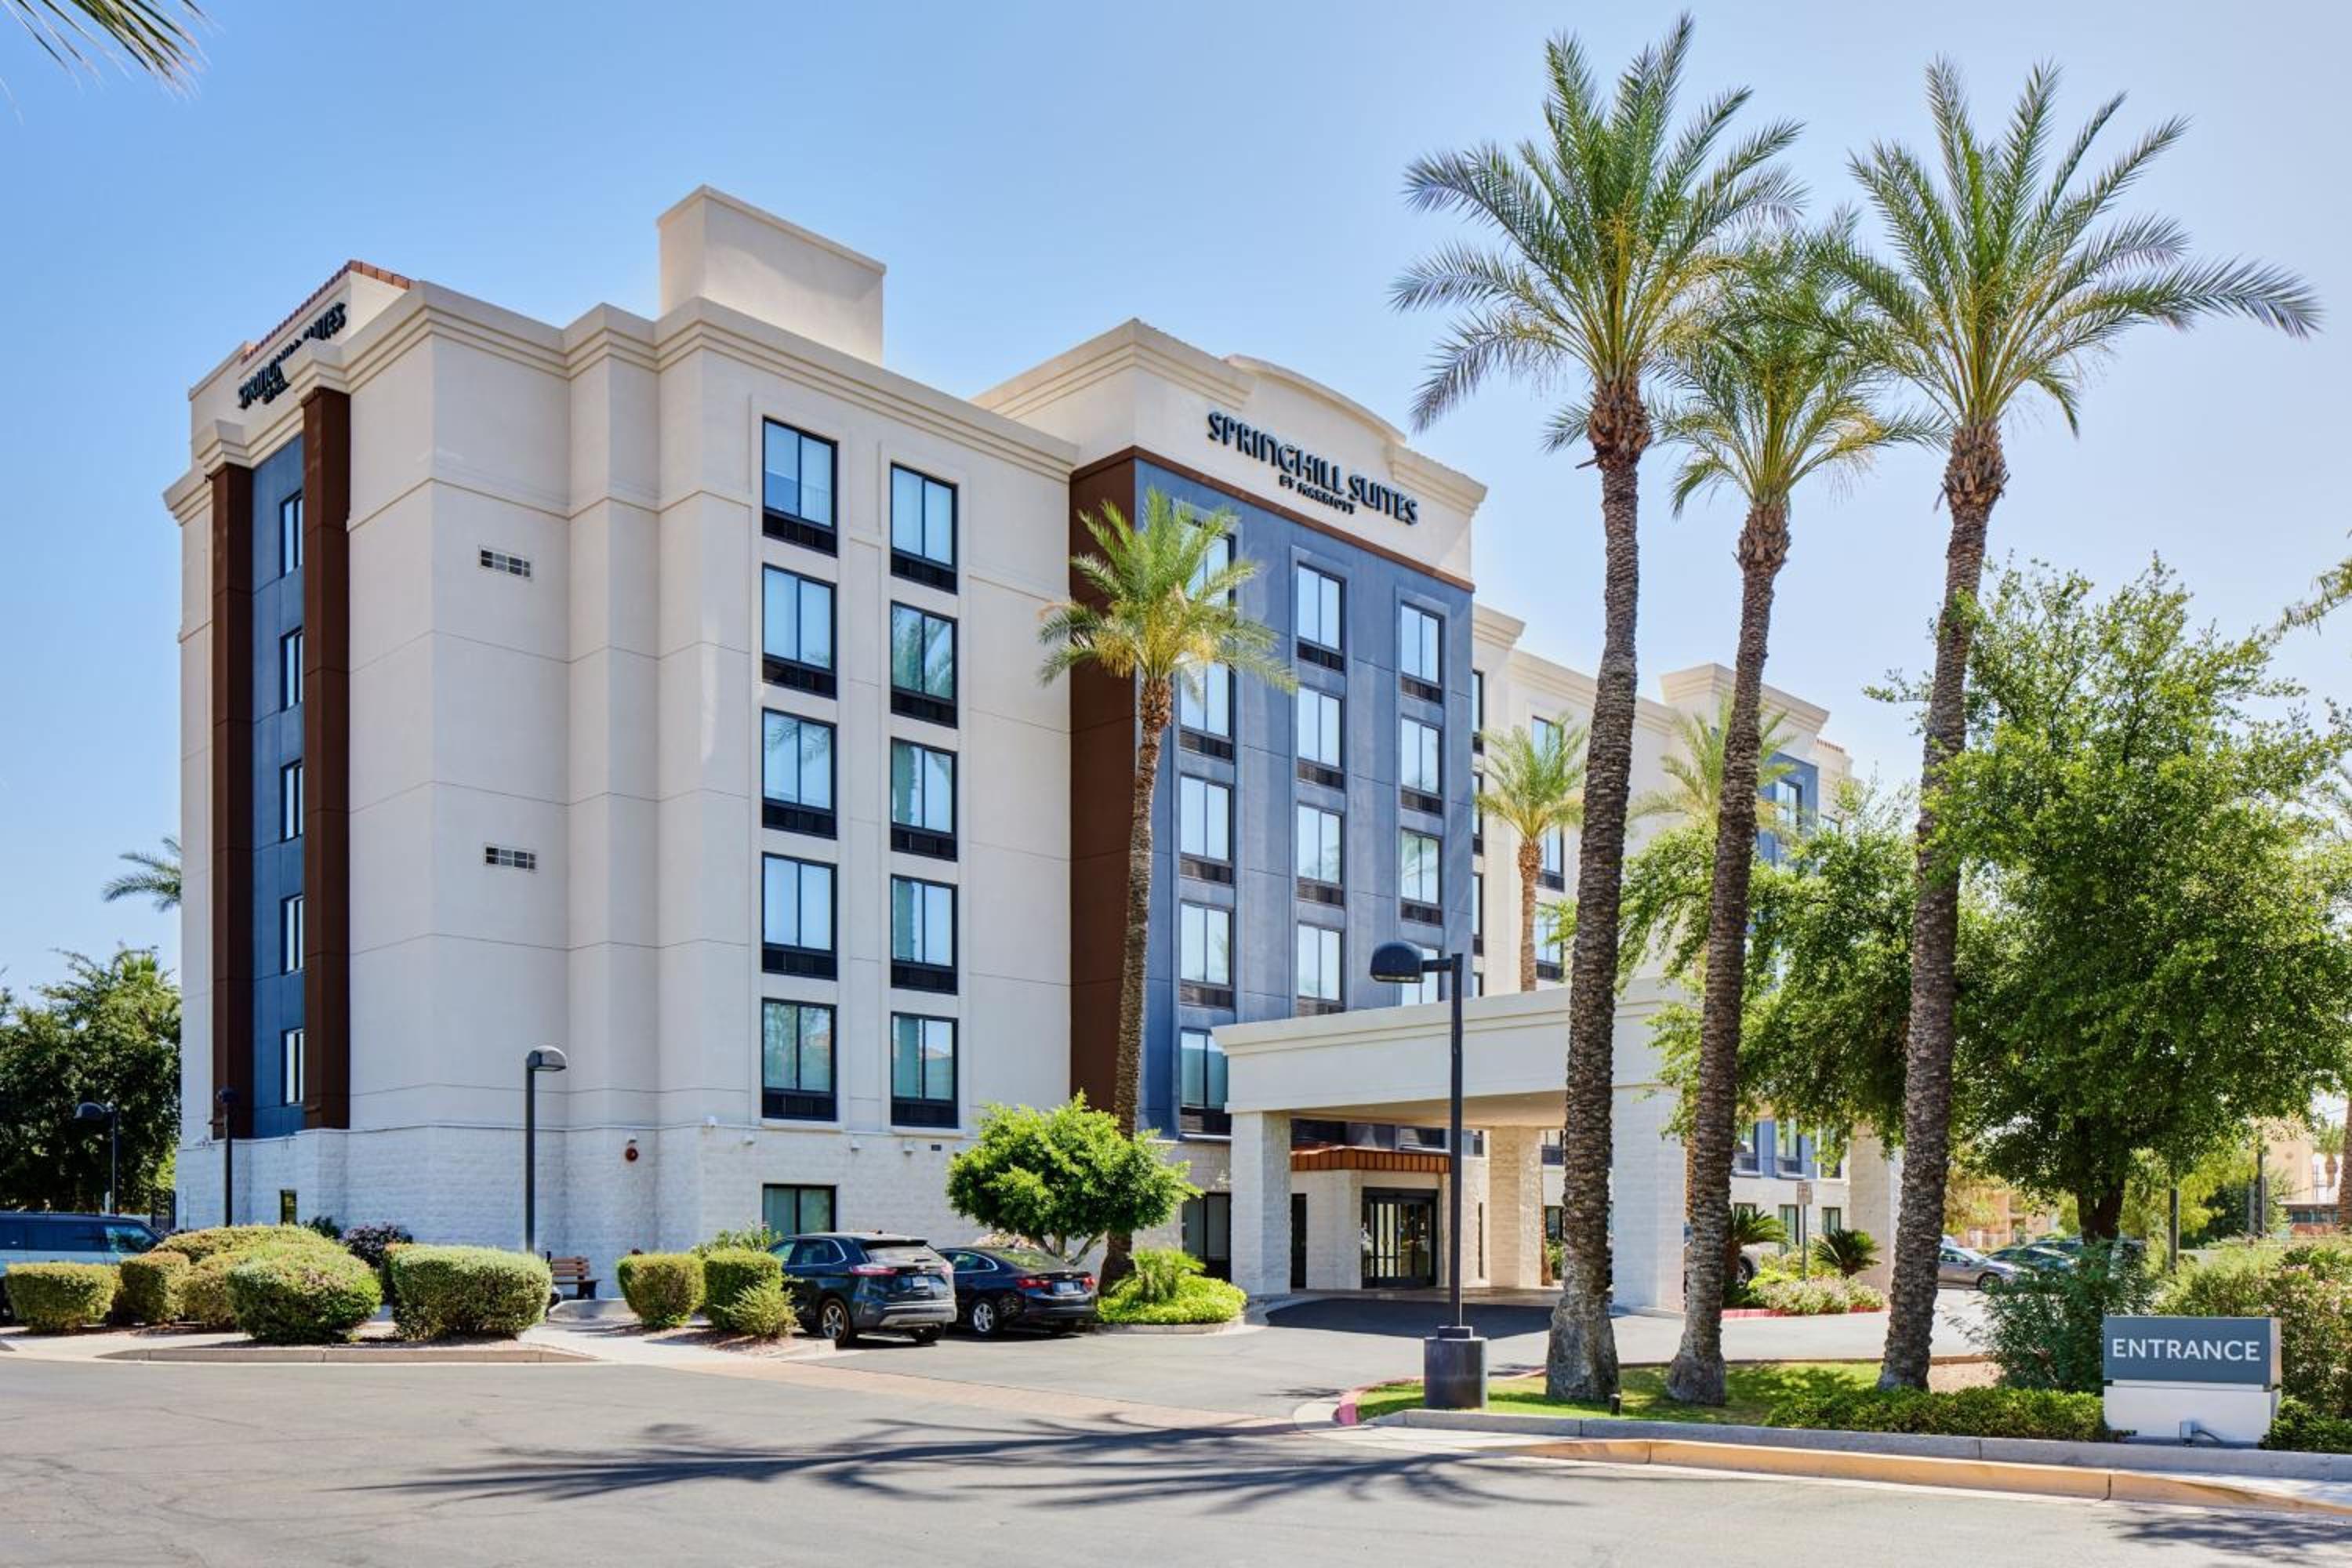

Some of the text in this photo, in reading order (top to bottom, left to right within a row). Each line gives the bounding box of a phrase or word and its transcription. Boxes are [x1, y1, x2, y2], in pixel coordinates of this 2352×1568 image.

[1207, 411, 1418, 526] SPRINGHILL SUITES
[2112, 1338, 2261, 1362] ENTRANCE
